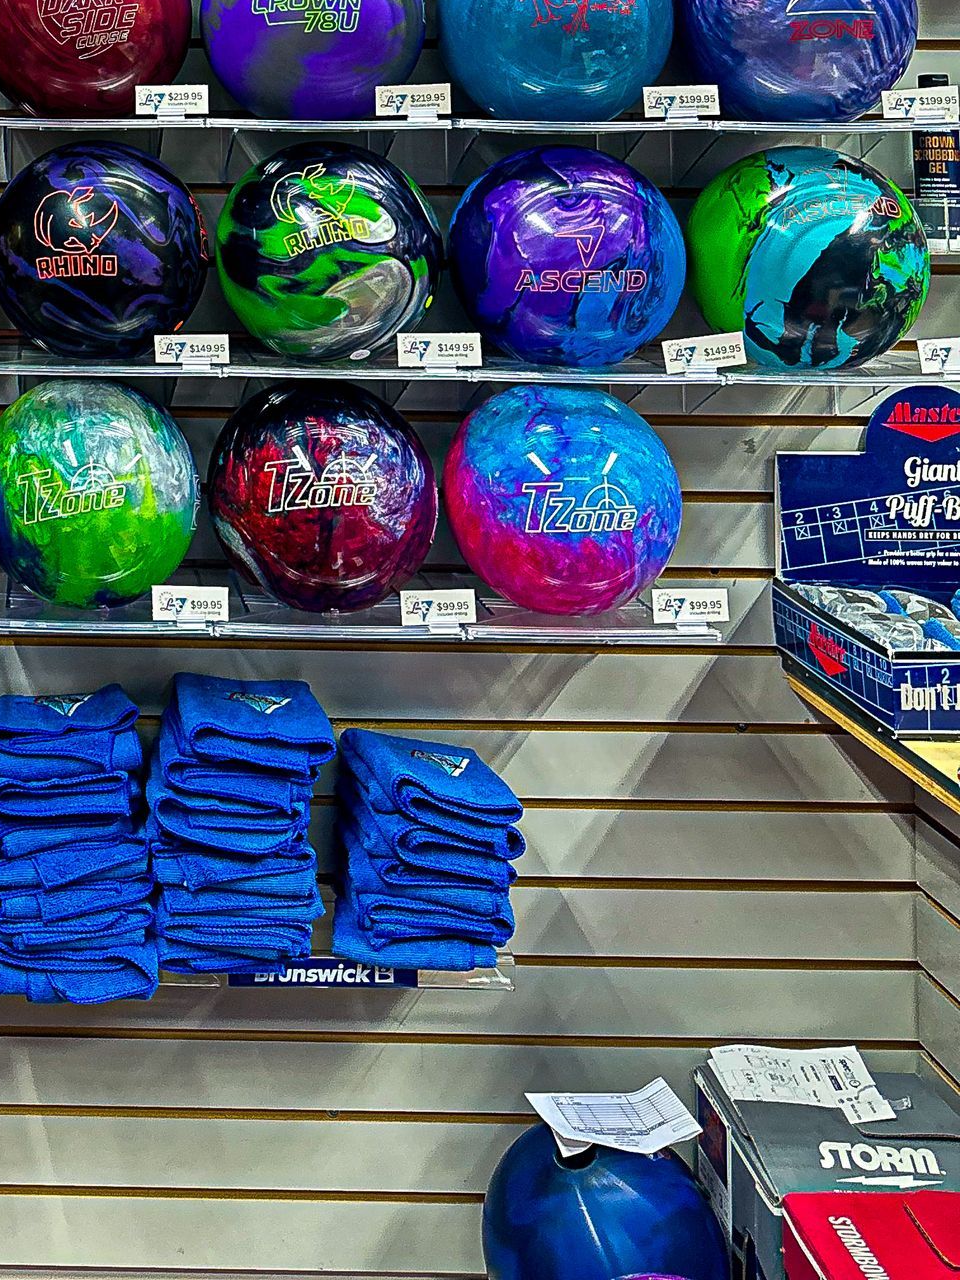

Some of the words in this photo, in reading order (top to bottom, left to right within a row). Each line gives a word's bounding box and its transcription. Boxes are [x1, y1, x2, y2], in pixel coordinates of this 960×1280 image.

[60, 5, 138, 37] SIDE
[305, 11, 359, 33] 78U
[790, 19, 874, 42] ZONE
[75, 30, 130, 50] CURSE
[411, 94, 445, 102] $219.95
[679, 95, 715, 104] $199.95
[919, 136, 955, 148] CROWN
[929, 162, 948, 174] GEL
[781, 196, 901, 231] ASCEND
[285, 217, 370, 257] RHINO
[36, 254, 118, 279] RHINO
[515, 269, 647, 293] ASCEND
[190, 344, 225, 352] $149.95
[704, 344, 741, 356] $149.95
[868, 531, 890, 539] KEEPS
[892, 531, 917, 539] HANDS
[191, 601, 222, 609] $99.95
[437, 602, 468, 611] $99.95
[689, 601, 721, 610] $99.95
[900, 683, 950, 711] Don't
[819, 1141, 941, 1175] STORM
